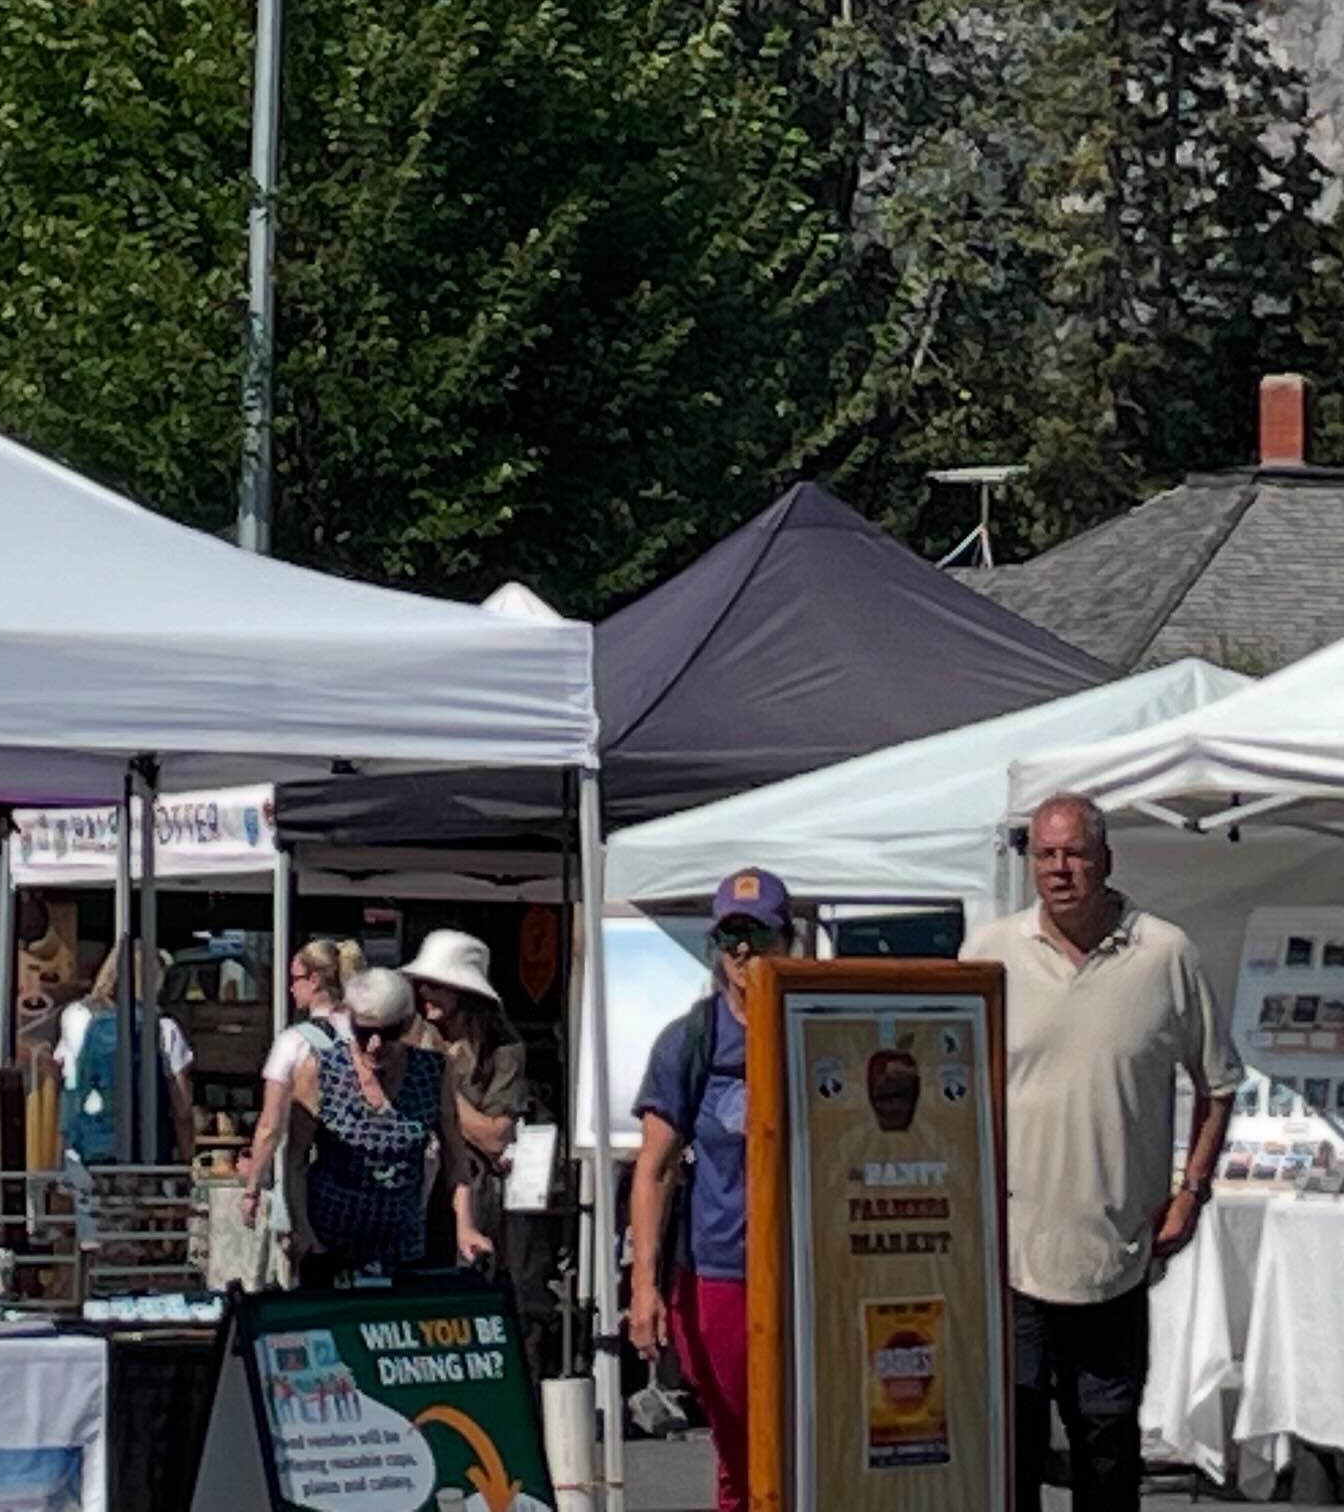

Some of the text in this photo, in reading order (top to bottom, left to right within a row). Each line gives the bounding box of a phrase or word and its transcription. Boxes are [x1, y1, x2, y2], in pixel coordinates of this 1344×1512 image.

[848, 1232, 951, 1257] MARKET
[359, 1314, 508, 1351] WILL YOU BE
[376, 1350, 505, 1387] DINING IN?
